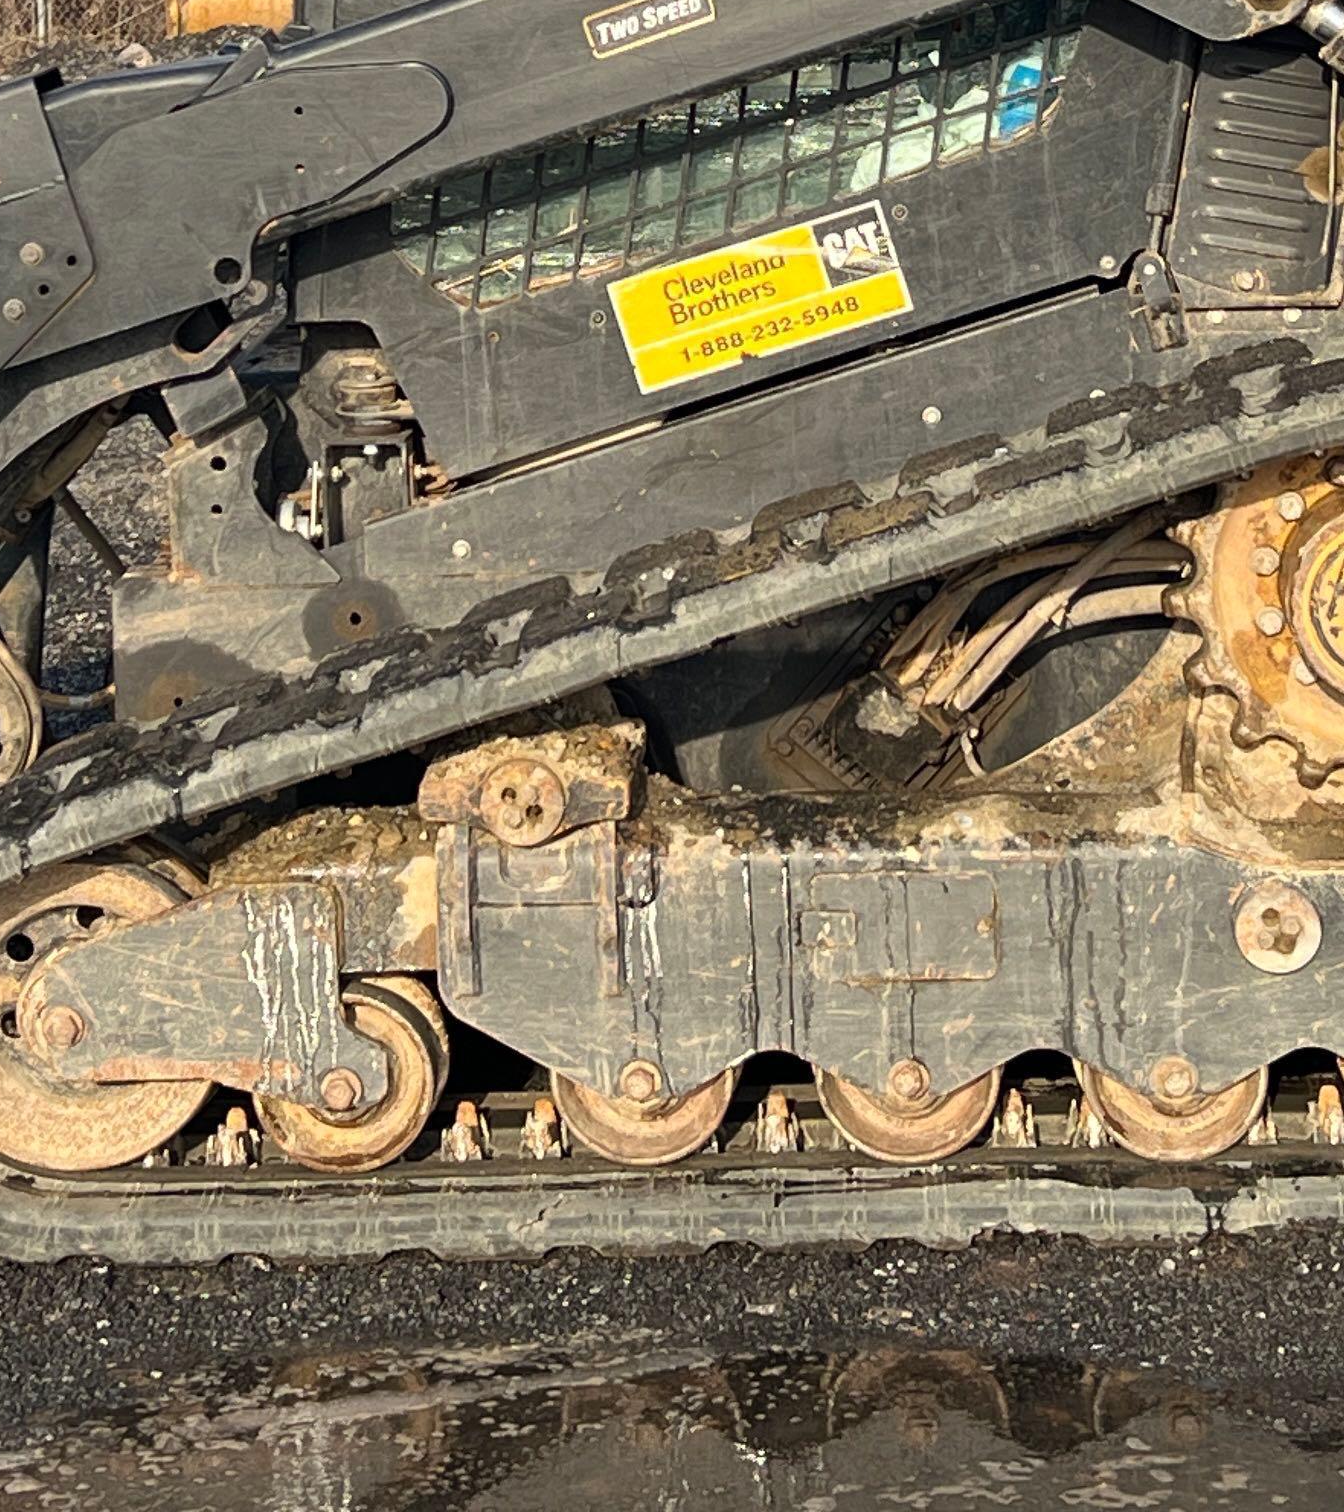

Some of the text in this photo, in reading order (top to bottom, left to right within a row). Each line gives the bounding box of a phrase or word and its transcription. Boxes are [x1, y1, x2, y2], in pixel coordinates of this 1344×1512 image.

[822, 220, 880, 269] CAT
[667, 280, 777, 326] Brothers
[679, 296, 860, 363] 1-888-232-5948
